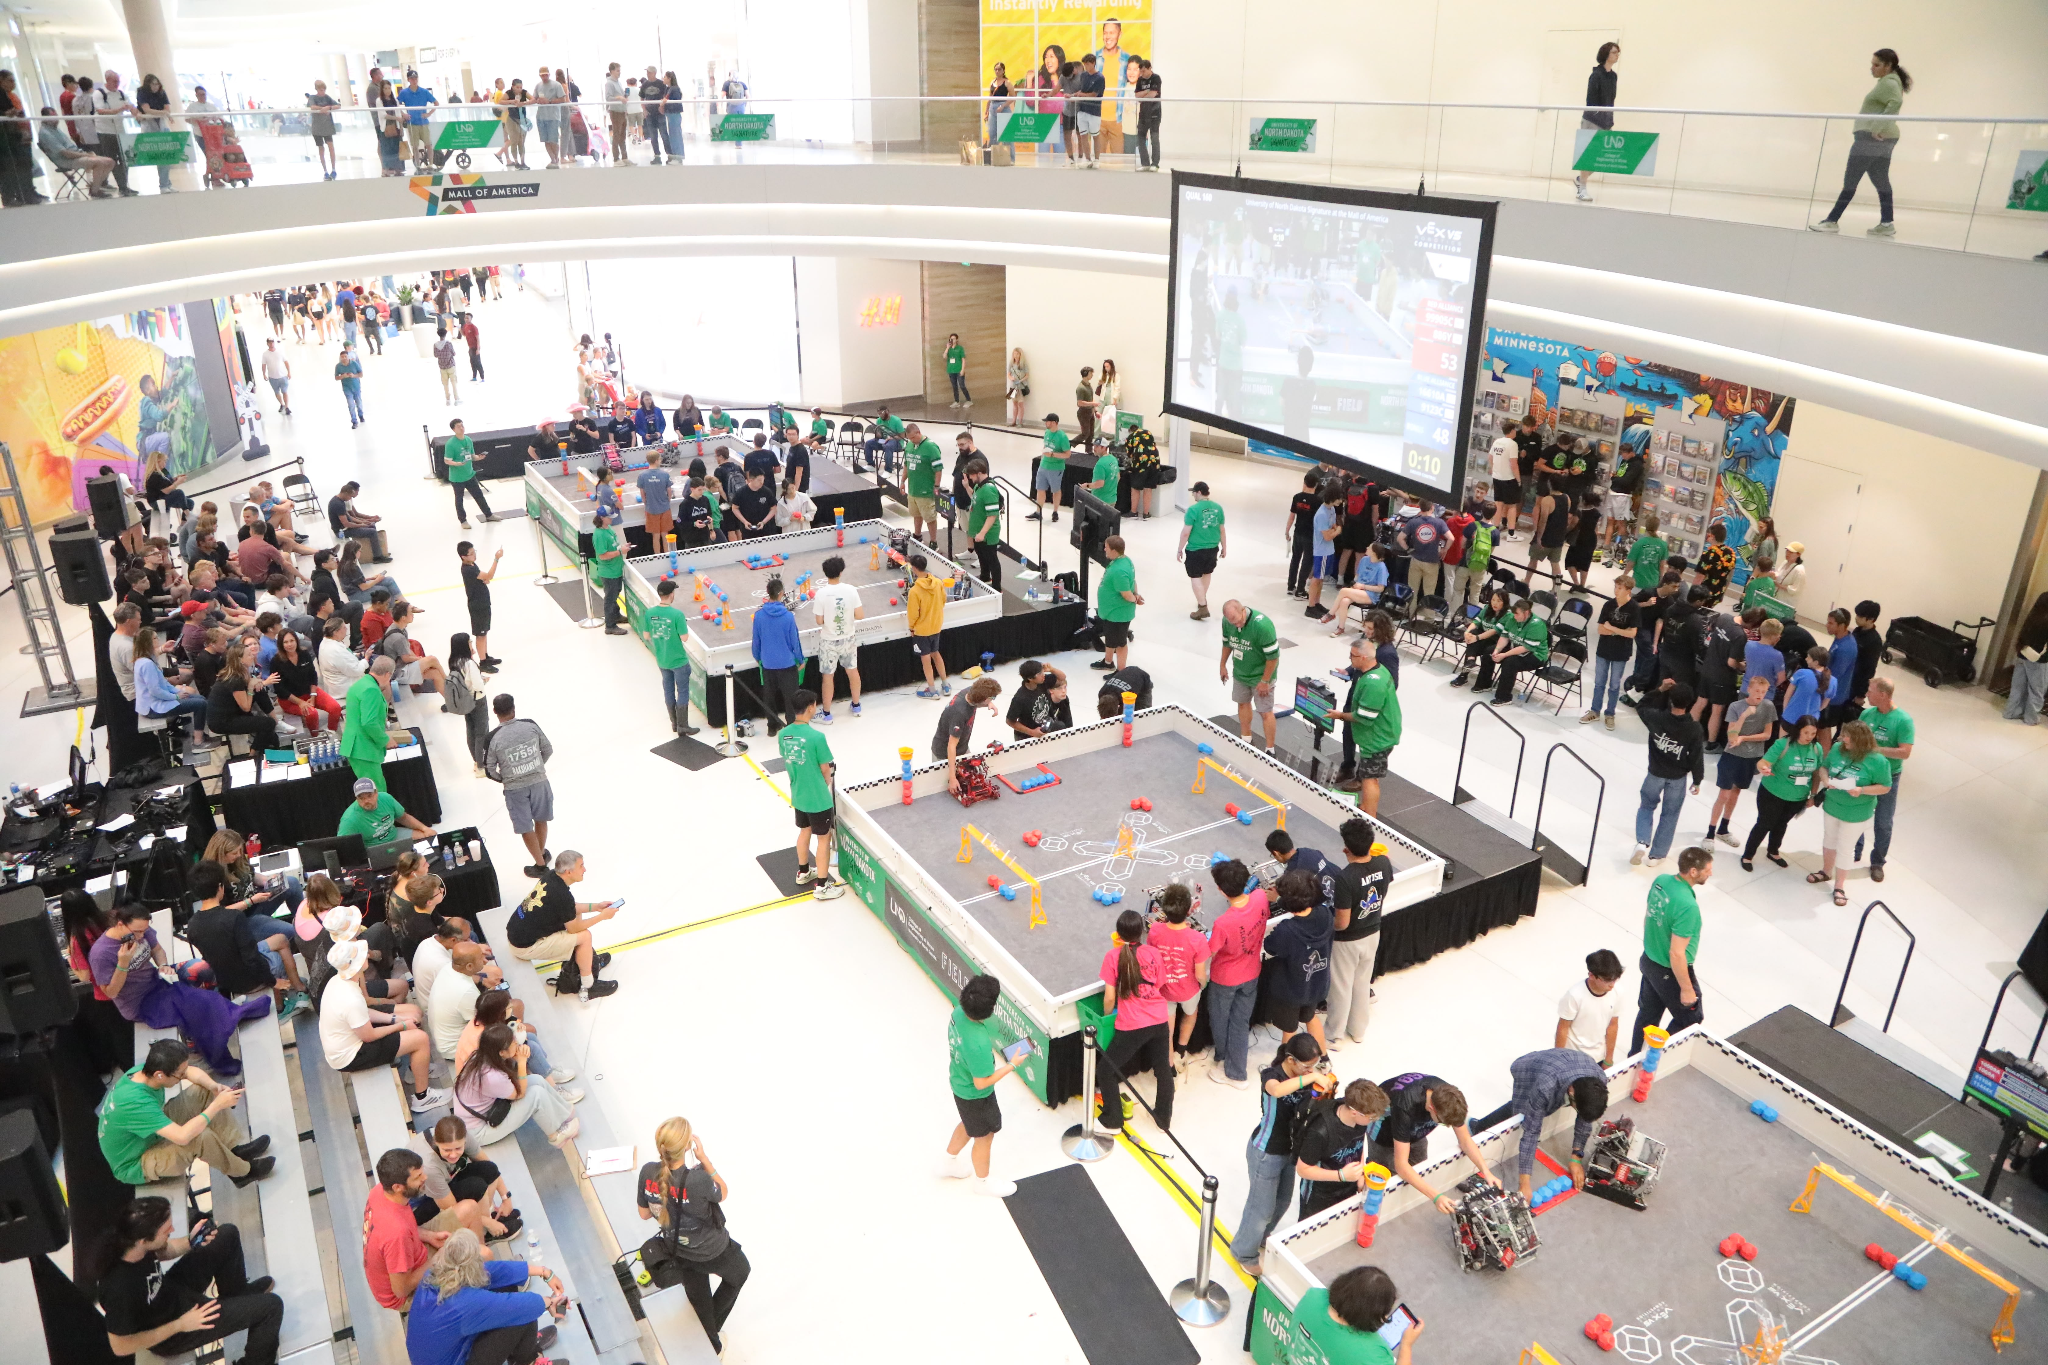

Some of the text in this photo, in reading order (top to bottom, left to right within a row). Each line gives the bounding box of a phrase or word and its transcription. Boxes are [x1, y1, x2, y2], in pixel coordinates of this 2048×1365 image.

[990, 0, 1057, 12] Instantly
[1020, 116, 1035, 125] UND
[455, 123, 474, 133] UND
[1264, 128, 1304, 138] NORTH DAKOTA
[1604, 135, 1625, 149] UND
[448, 186, 534, 198] MALL OF AMERICA
[1185, 190, 1213, 202] QUAL 160
[1245, 199, 1268, 210] University
[1275, 202, 1289, 210] North
[1289, 203, 1306, 213] Dakota
[1307, 205, 1331, 216] Signature
[1338, 210, 1347, 218] the
[1348, 211, 1360, 219] Mall
[1367, 214, 1389, 223] America
[1416, 222, 1445, 238] VEX
[1414, 240, 1462, 253] COMPETITION
[1438, 302, 1464, 313] ALLIANCE
[1440, 352, 1458, 371] 53
[1337, 397, 1363, 412] FIELD
[1421, 403, 1444, 417] 9123C
[1432, 427, 1450, 445] 48
[1408, 450, 1441, 475] 0:10
[508, 743, 537, 762] 1755K
[855, 854, 876, 884] DAKOTA
[890, 897, 905, 924] UND
